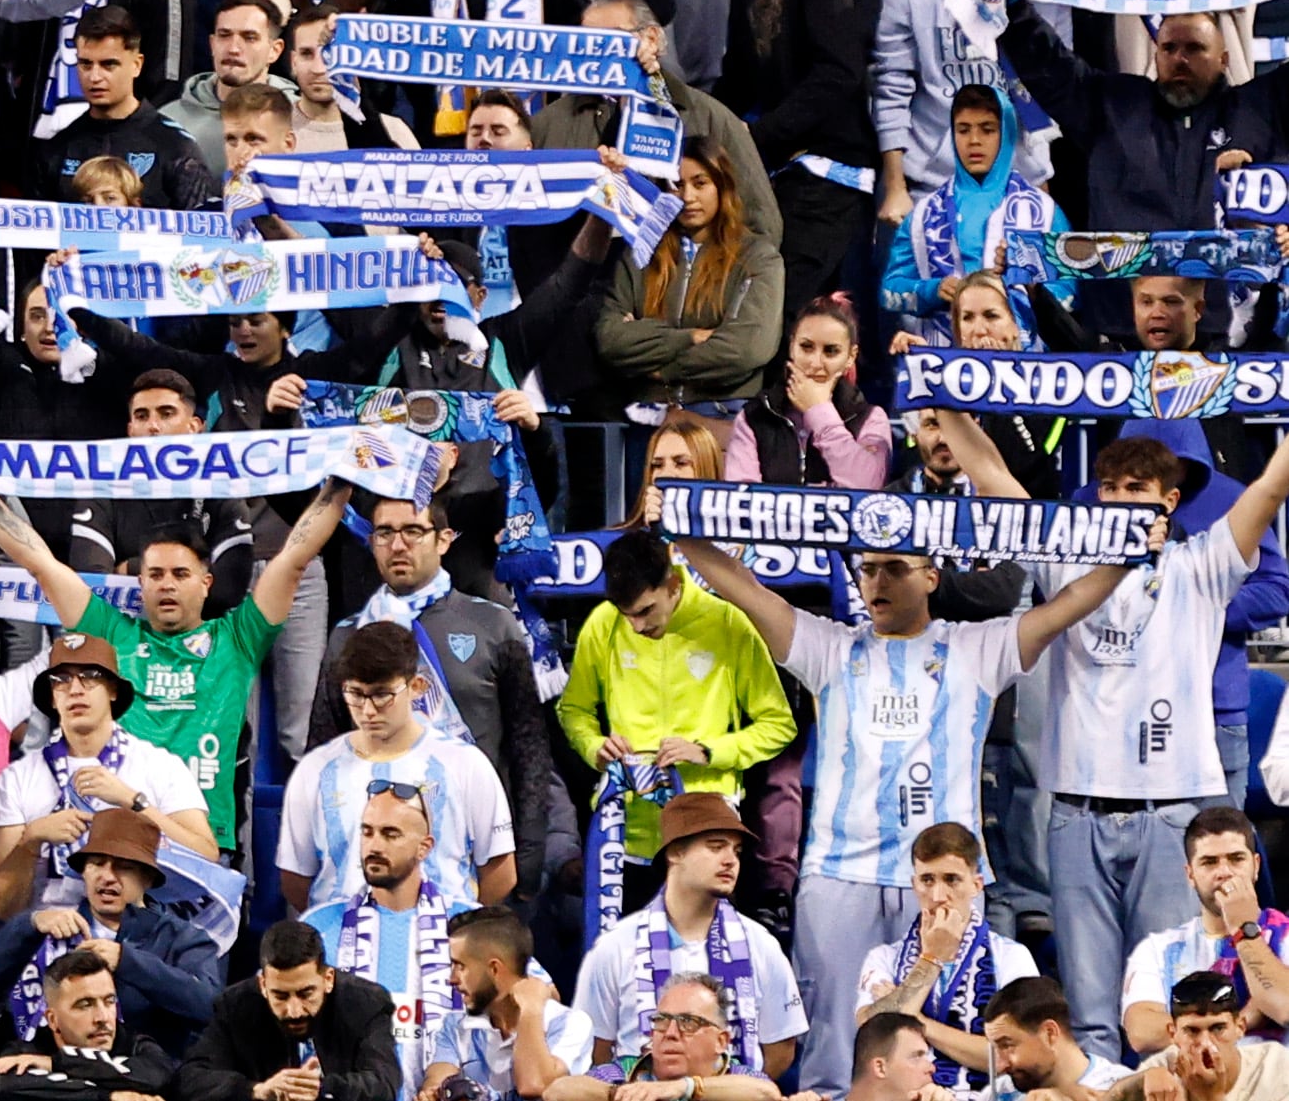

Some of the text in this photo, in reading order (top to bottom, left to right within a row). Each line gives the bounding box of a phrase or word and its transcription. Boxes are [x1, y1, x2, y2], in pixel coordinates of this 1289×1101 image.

[348, 17, 557, 52] NOBLE Y MUY
[422, 52, 463, 79] DE
[297, 161, 543, 208] MALAGA
[61, 205, 229, 238] INEXPLICA
[905, 355, 1134, 411] FONDO
[699, 480, 850, 543] HÉROES
[913, 500, 1159, 556] NI VILLANOS
[146, 681, 197, 702] laga
[1150, 698, 1173, 752] Olin
[908, 761, 933, 815] Olin
